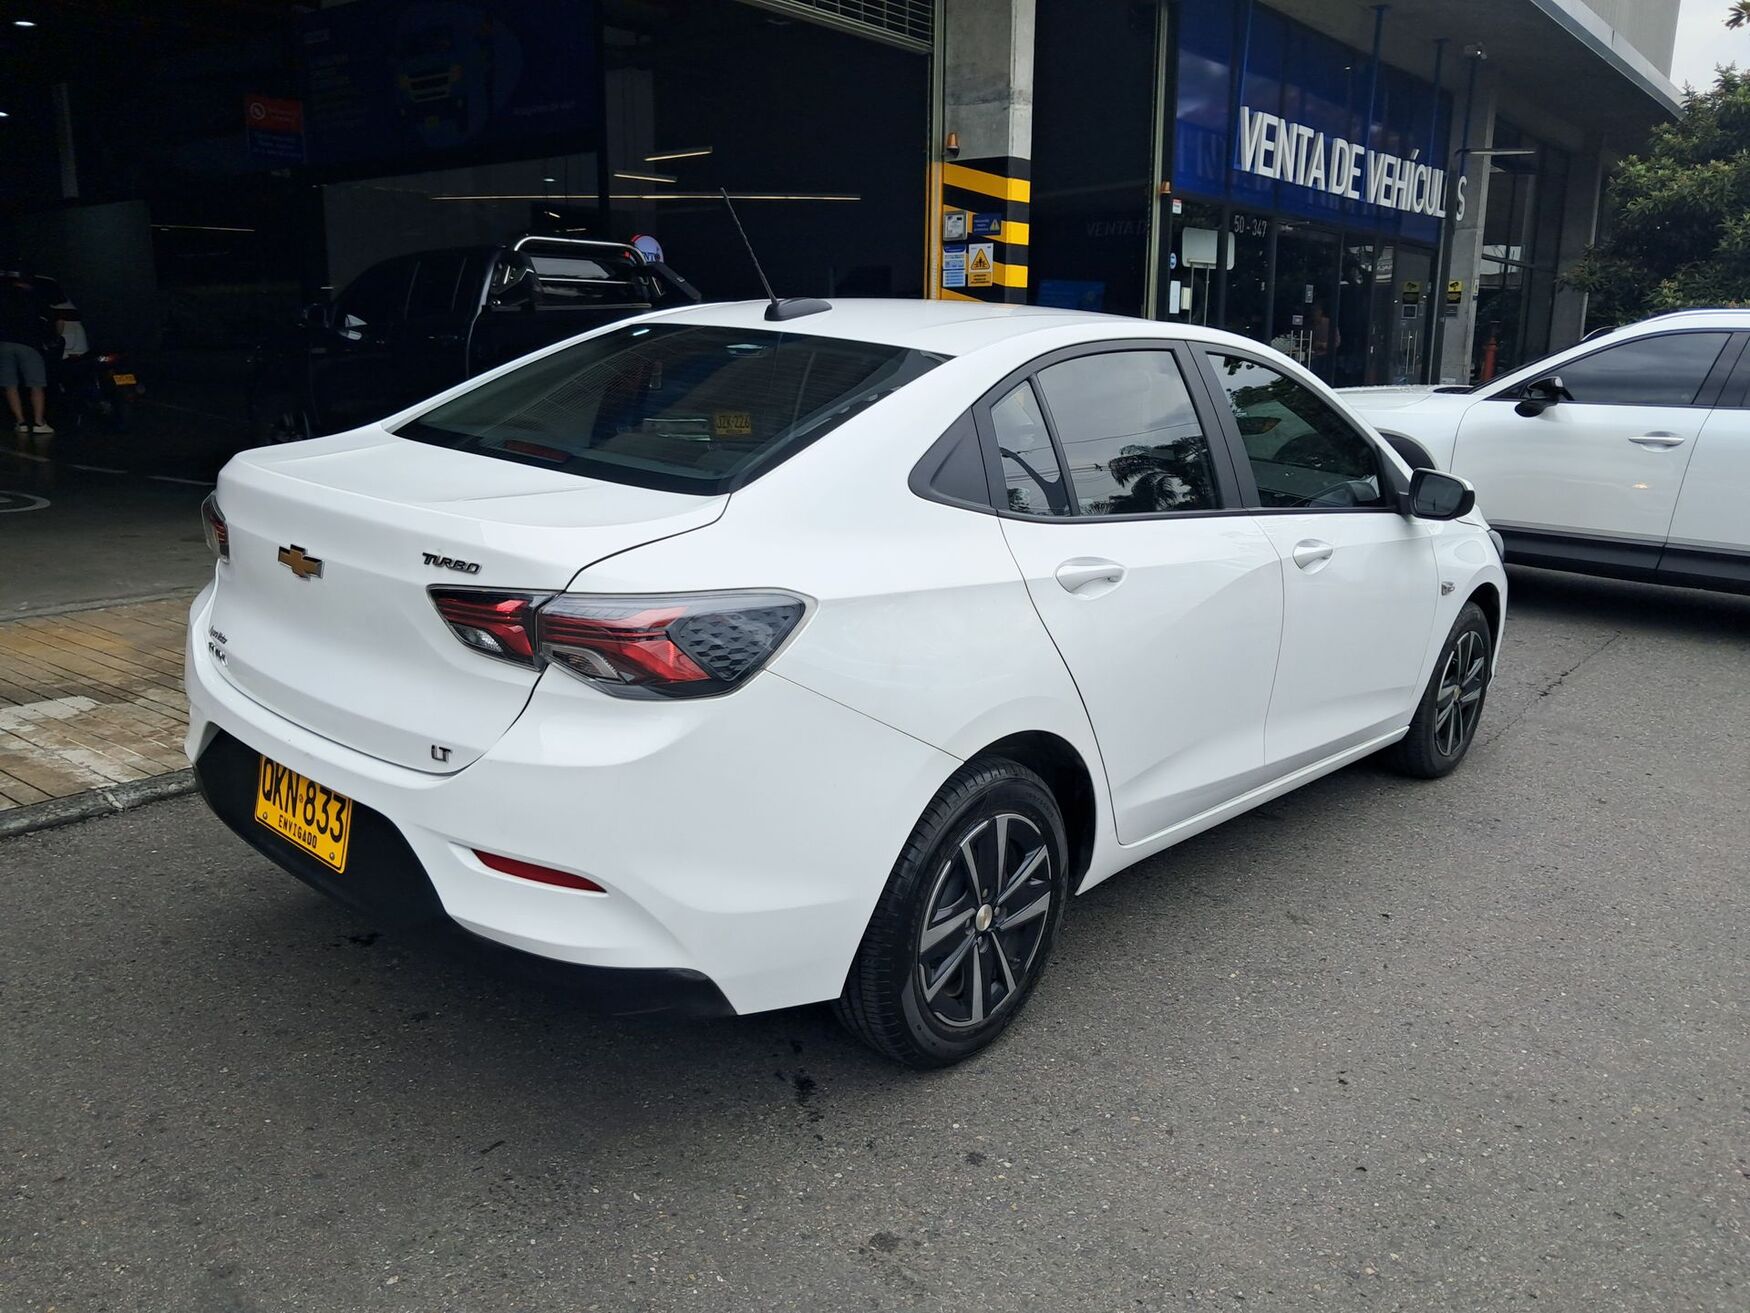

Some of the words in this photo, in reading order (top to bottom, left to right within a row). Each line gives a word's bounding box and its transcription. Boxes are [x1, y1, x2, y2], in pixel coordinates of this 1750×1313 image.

[1240, 105, 1325, 190] VENTA
[1328, 137, 1366, 200] DE
[1366, 148, 1467, 221] VEHÍCULS
[1234, 215, 1245, 234] 50
[1252, 218, 1267, 238] 347
[422, 552, 482, 575] TURBO
[431, 744, 452, 763] LT
[278, 814, 318, 849] ENVIGADO
